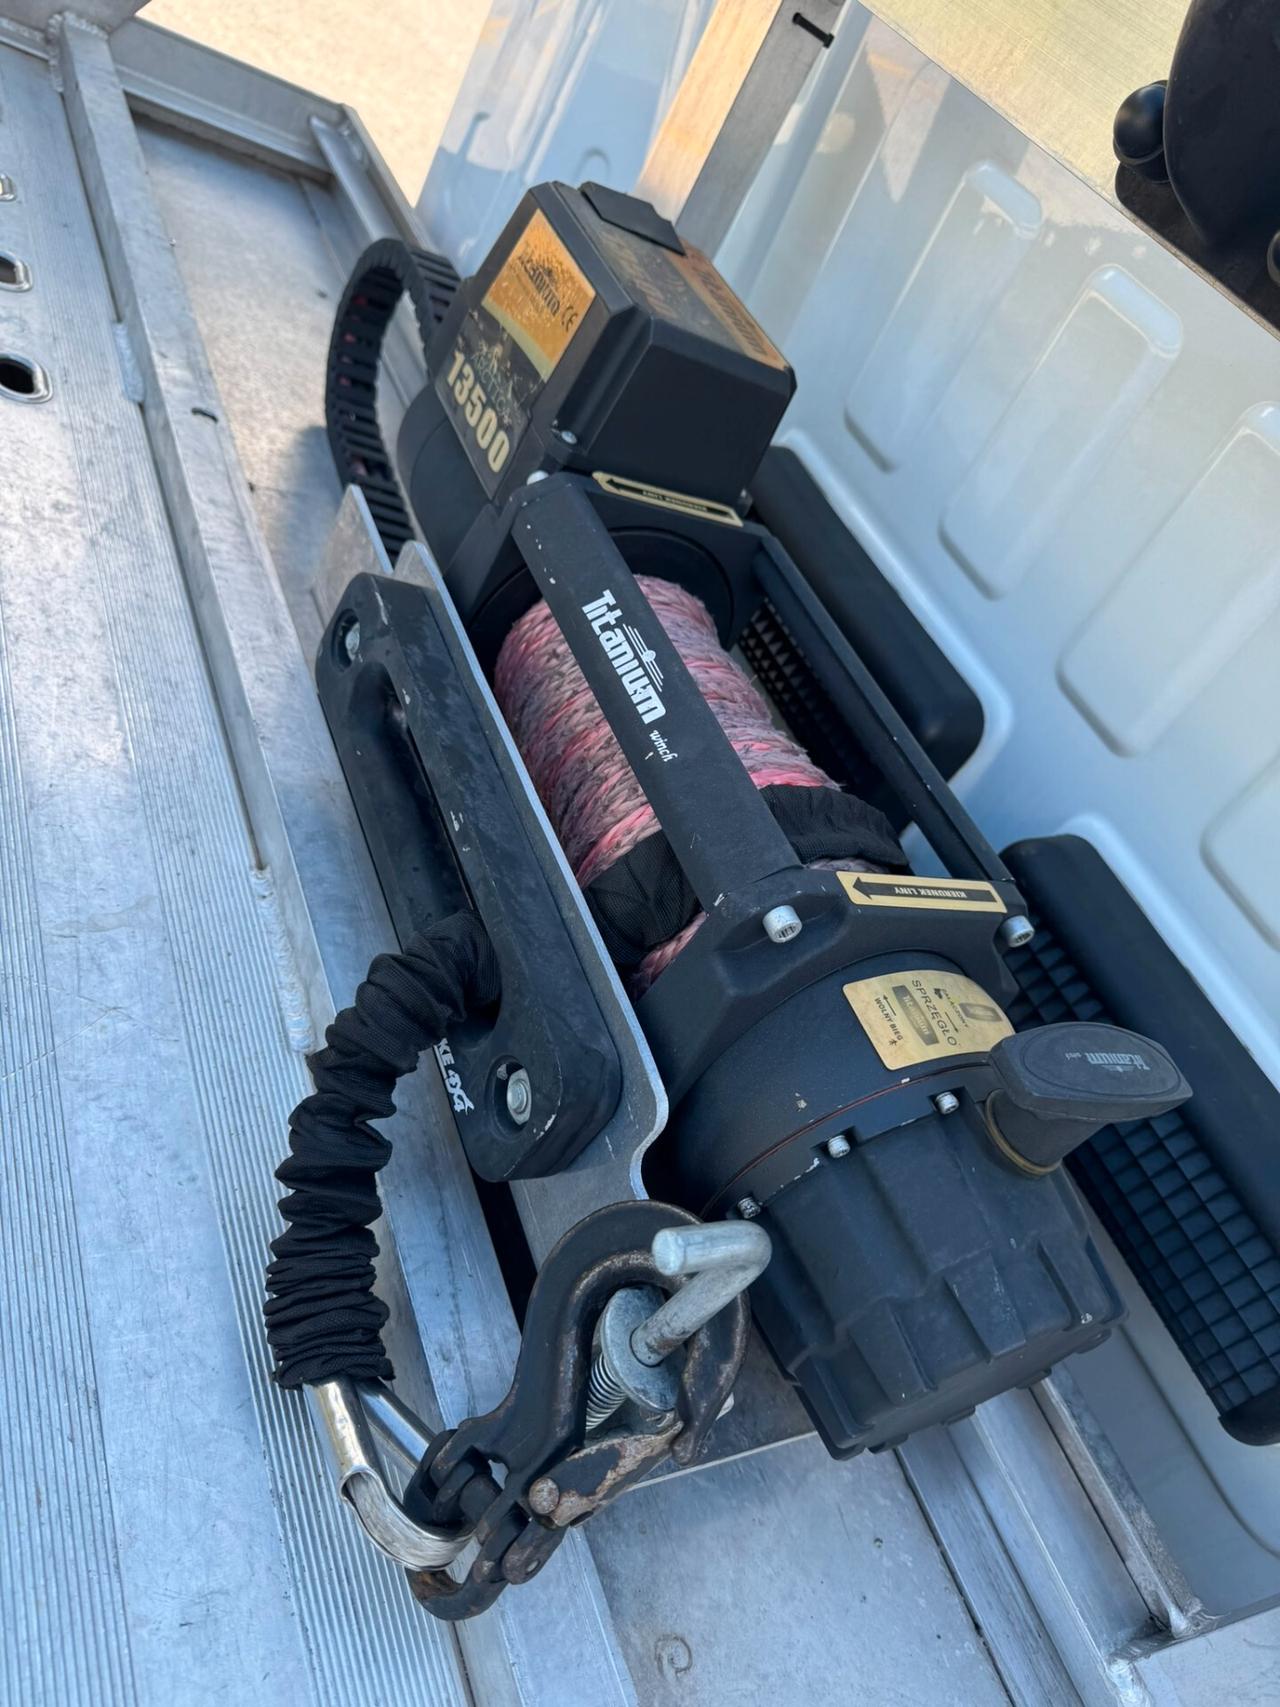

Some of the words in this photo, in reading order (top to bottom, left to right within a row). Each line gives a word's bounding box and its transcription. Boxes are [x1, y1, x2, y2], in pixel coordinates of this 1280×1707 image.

[447, 350, 510, 473] 13500
[582, 589, 667, 724] Titanium
[649, 730, 678, 762] winch
[894, 886, 919, 895] LINY
[874, 997, 893, 1023] WOLNY
[890, 1019, 903, 1041] BIEG
[912, 980, 957, 1046] SPRZĘGŁO
